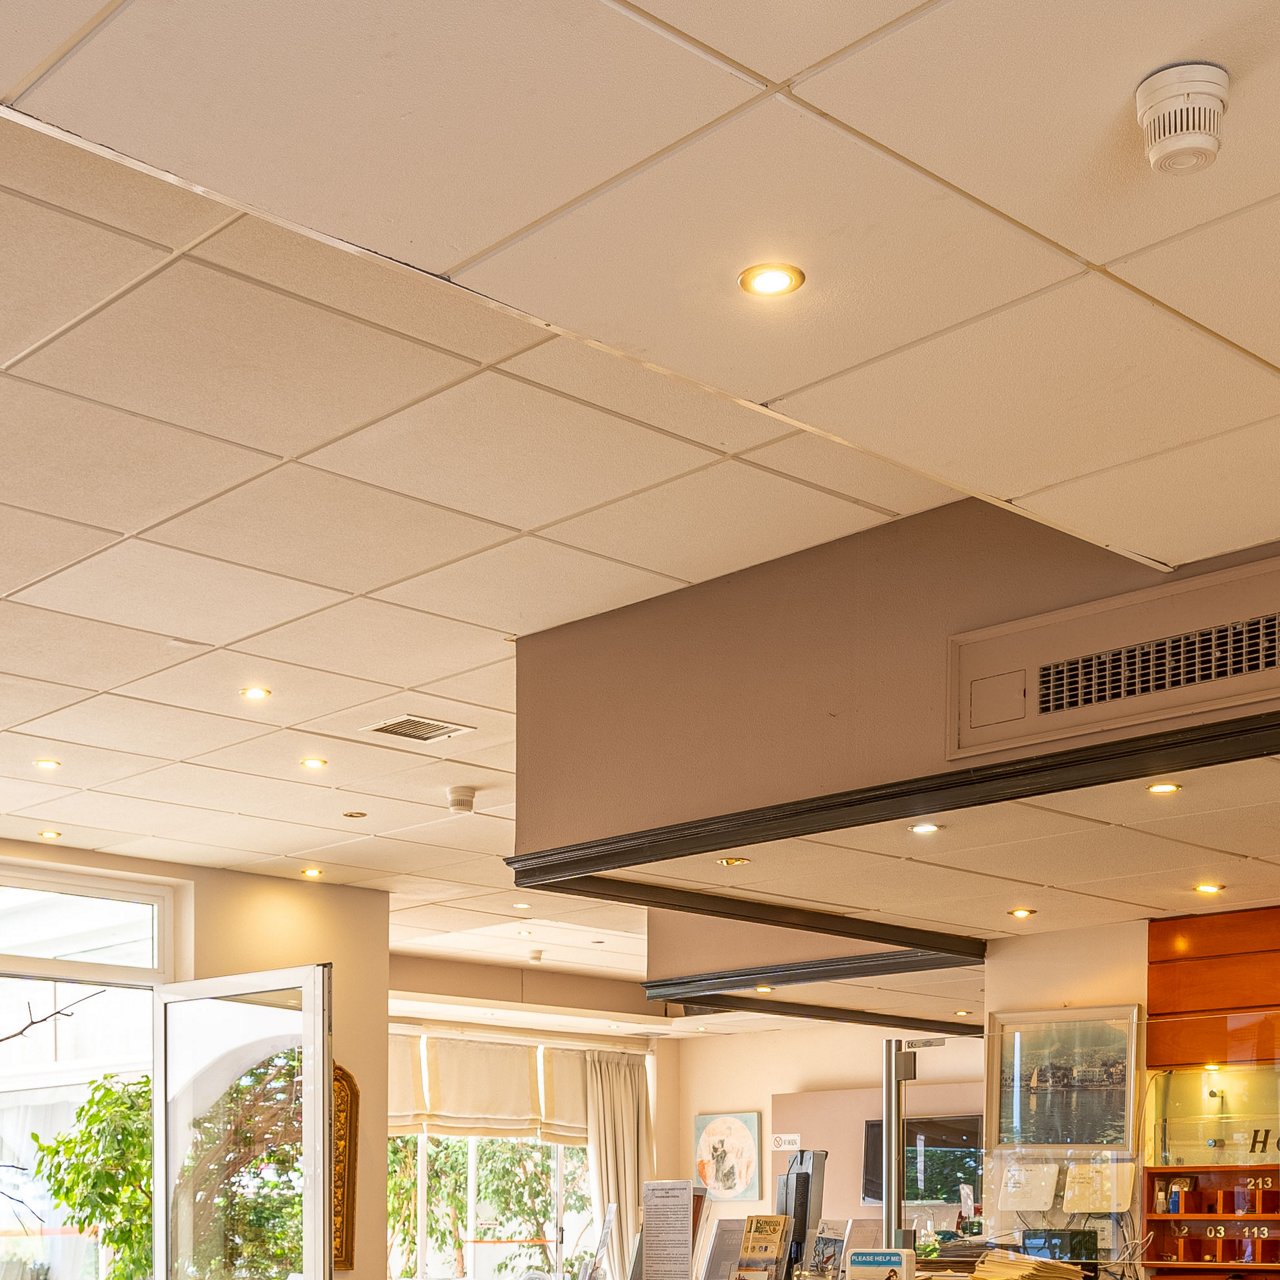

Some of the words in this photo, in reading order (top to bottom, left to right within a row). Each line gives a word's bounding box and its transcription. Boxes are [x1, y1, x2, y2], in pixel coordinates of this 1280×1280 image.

[1246, 1177, 1272, 1190] 213
[1207, 1226, 1225, 1238] 03
[1243, 1227, 1269, 1239] 113
